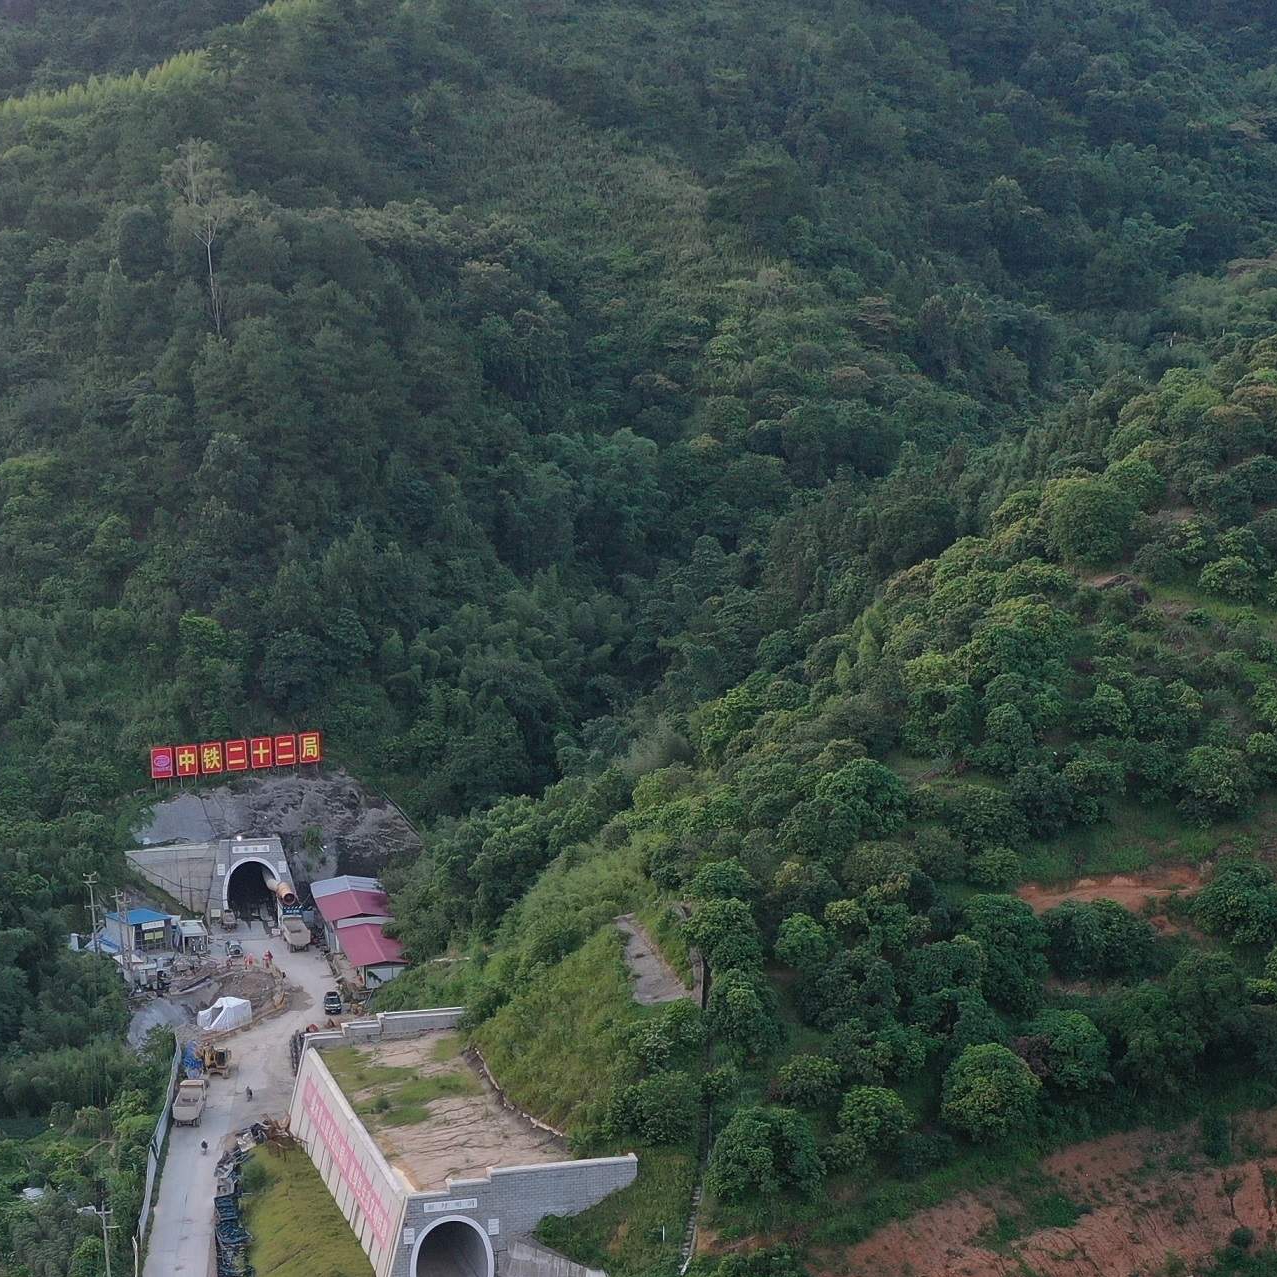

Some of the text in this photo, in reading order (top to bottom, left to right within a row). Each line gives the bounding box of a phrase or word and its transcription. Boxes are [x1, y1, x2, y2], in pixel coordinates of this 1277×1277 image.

[178, 736, 318, 772] 中铁二十二局
